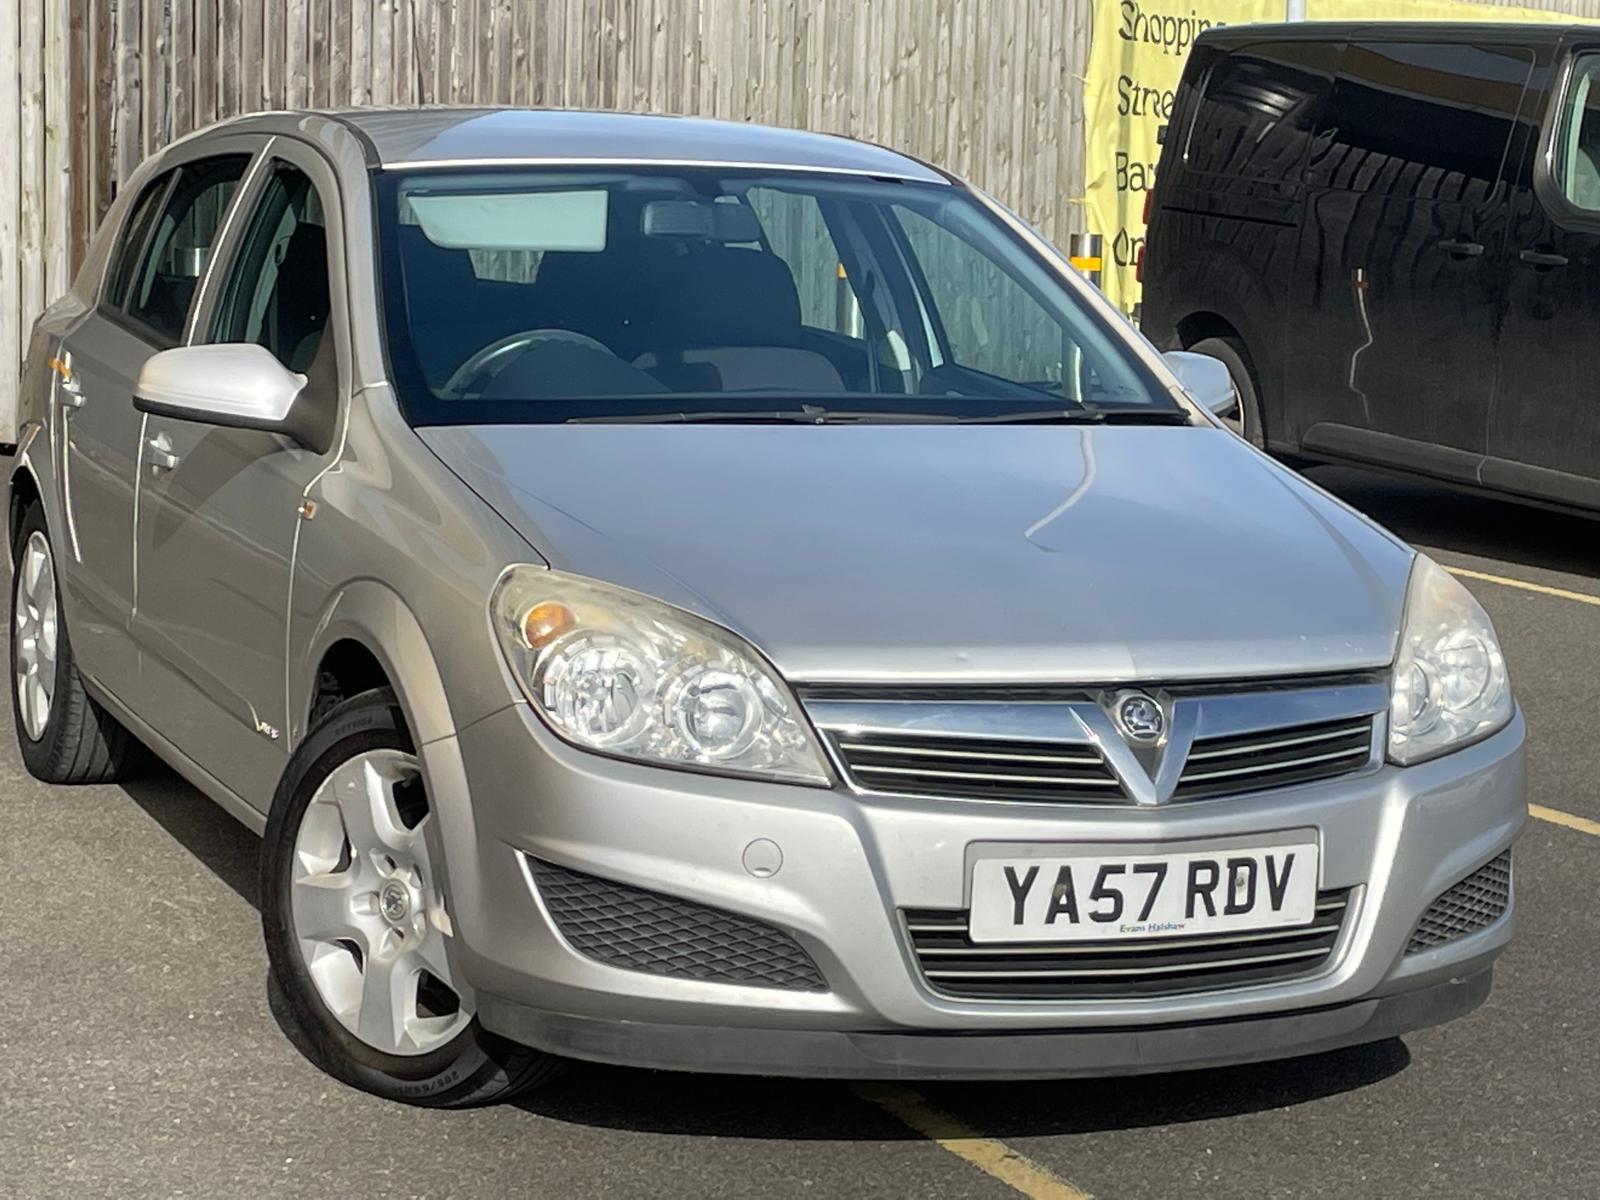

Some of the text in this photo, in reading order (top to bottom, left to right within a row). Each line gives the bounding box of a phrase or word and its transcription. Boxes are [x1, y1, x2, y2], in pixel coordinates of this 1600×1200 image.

[1119, 0, 1226, 56] Shoppi
[1118, 75, 1175, 120] Stree
[1003, 853, 1296, 925] YA57 RDV
[1119, 924, 1146, 933] Evans
